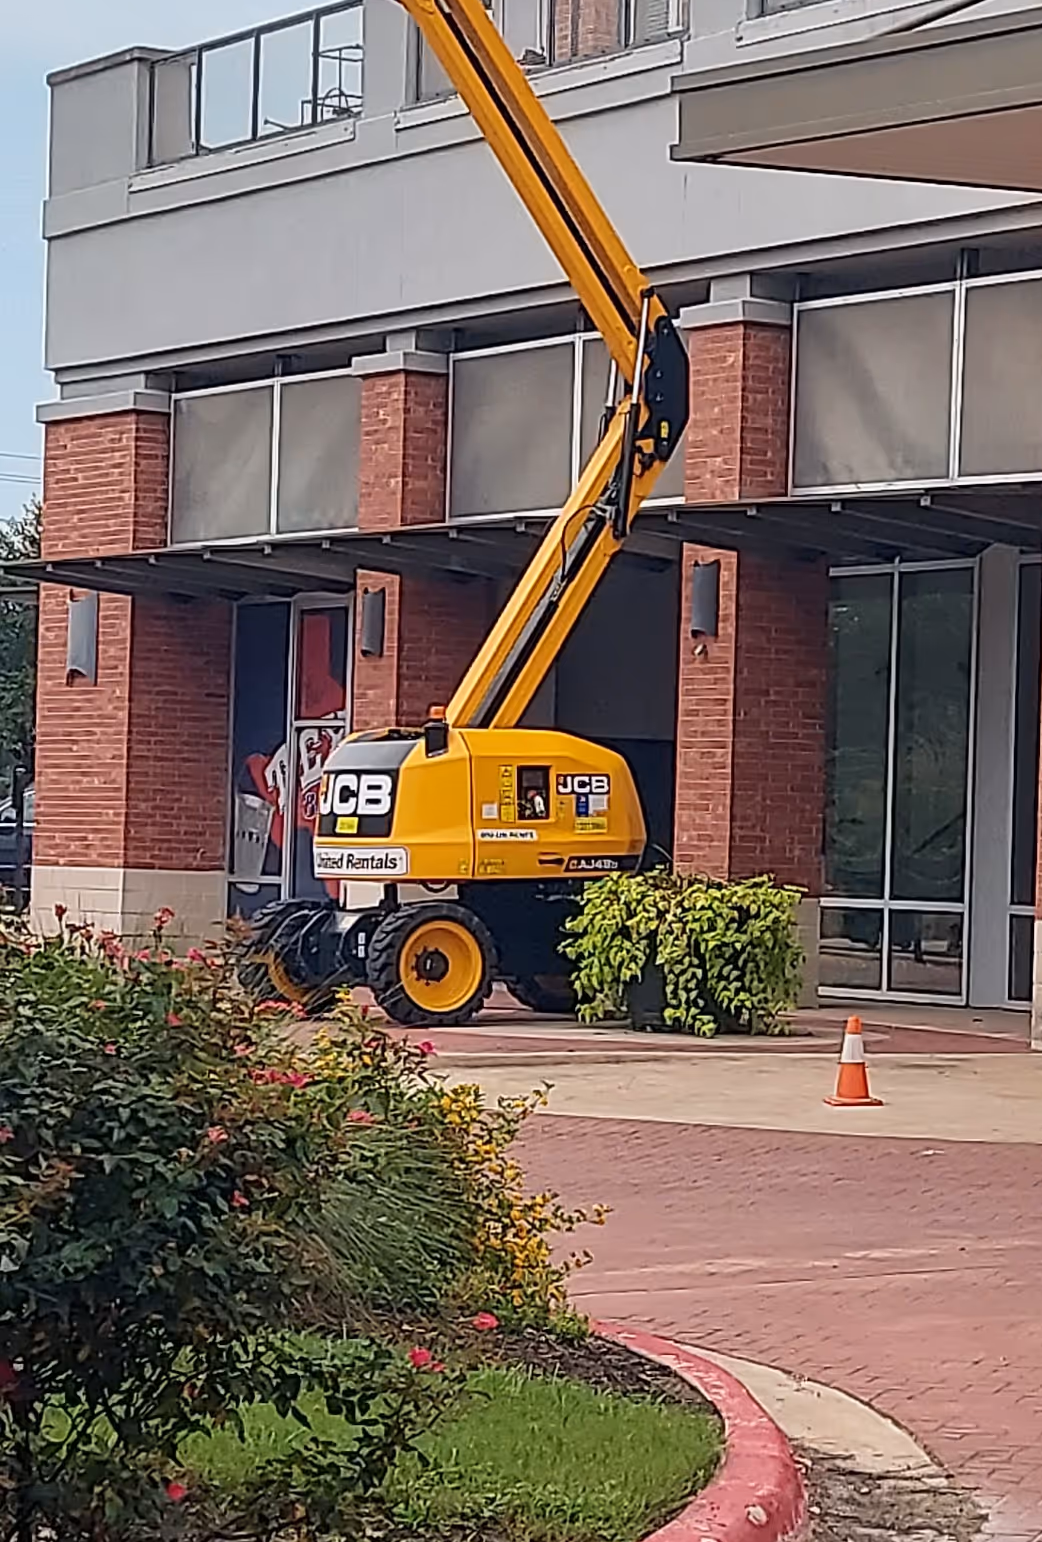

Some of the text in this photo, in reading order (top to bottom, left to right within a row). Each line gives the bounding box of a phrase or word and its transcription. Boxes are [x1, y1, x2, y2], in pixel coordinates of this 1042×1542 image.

[319, 773, 393, 815] JCB
[558, 775, 609, 794] JCB
[346, 852, 398, 869] Rentals
